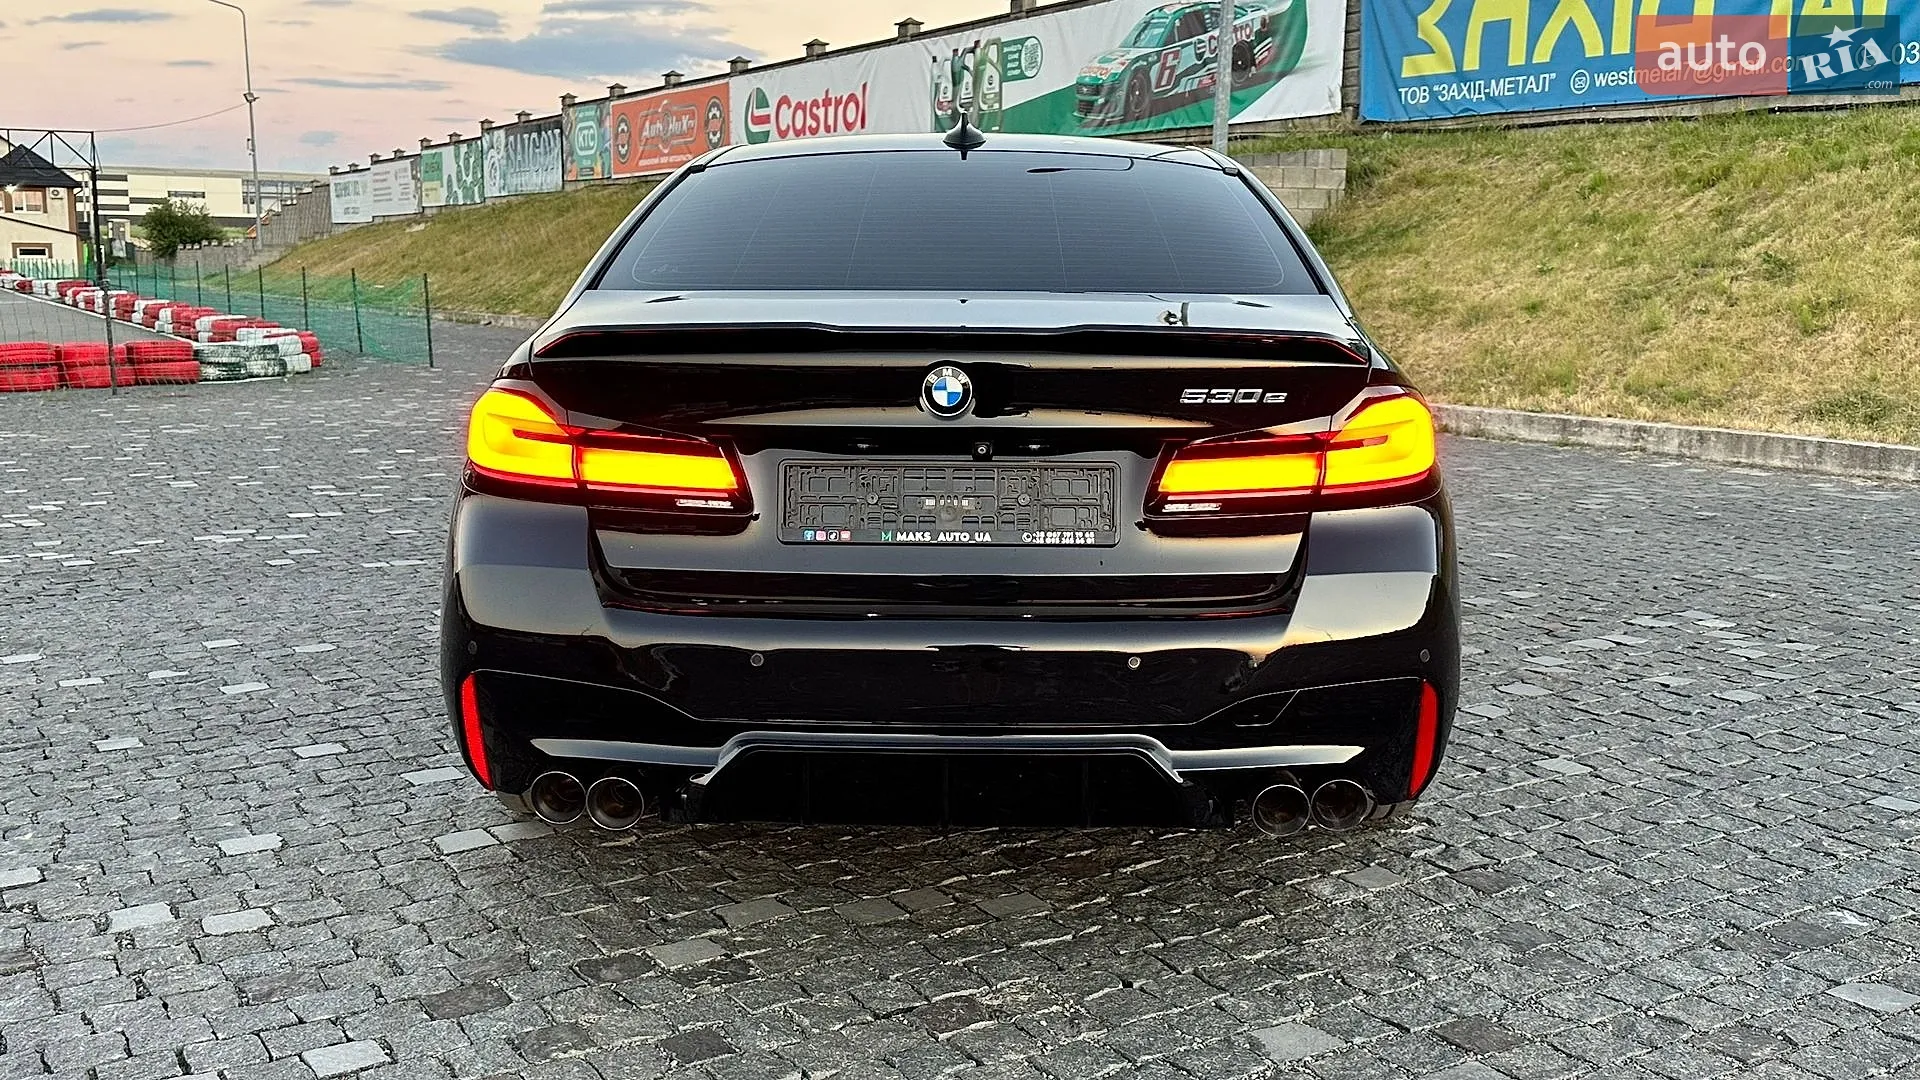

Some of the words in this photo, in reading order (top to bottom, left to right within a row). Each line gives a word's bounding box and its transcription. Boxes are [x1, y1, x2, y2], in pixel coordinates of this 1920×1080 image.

[1154, 48, 1181, 91] 6
[1398, 87, 1430, 105] ТОВ
[775, 81, 868, 139] Castrol
[1179, 388, 1288, 404] 530e
[896, 531, 992, 542] MAKS_AUTO_UA
